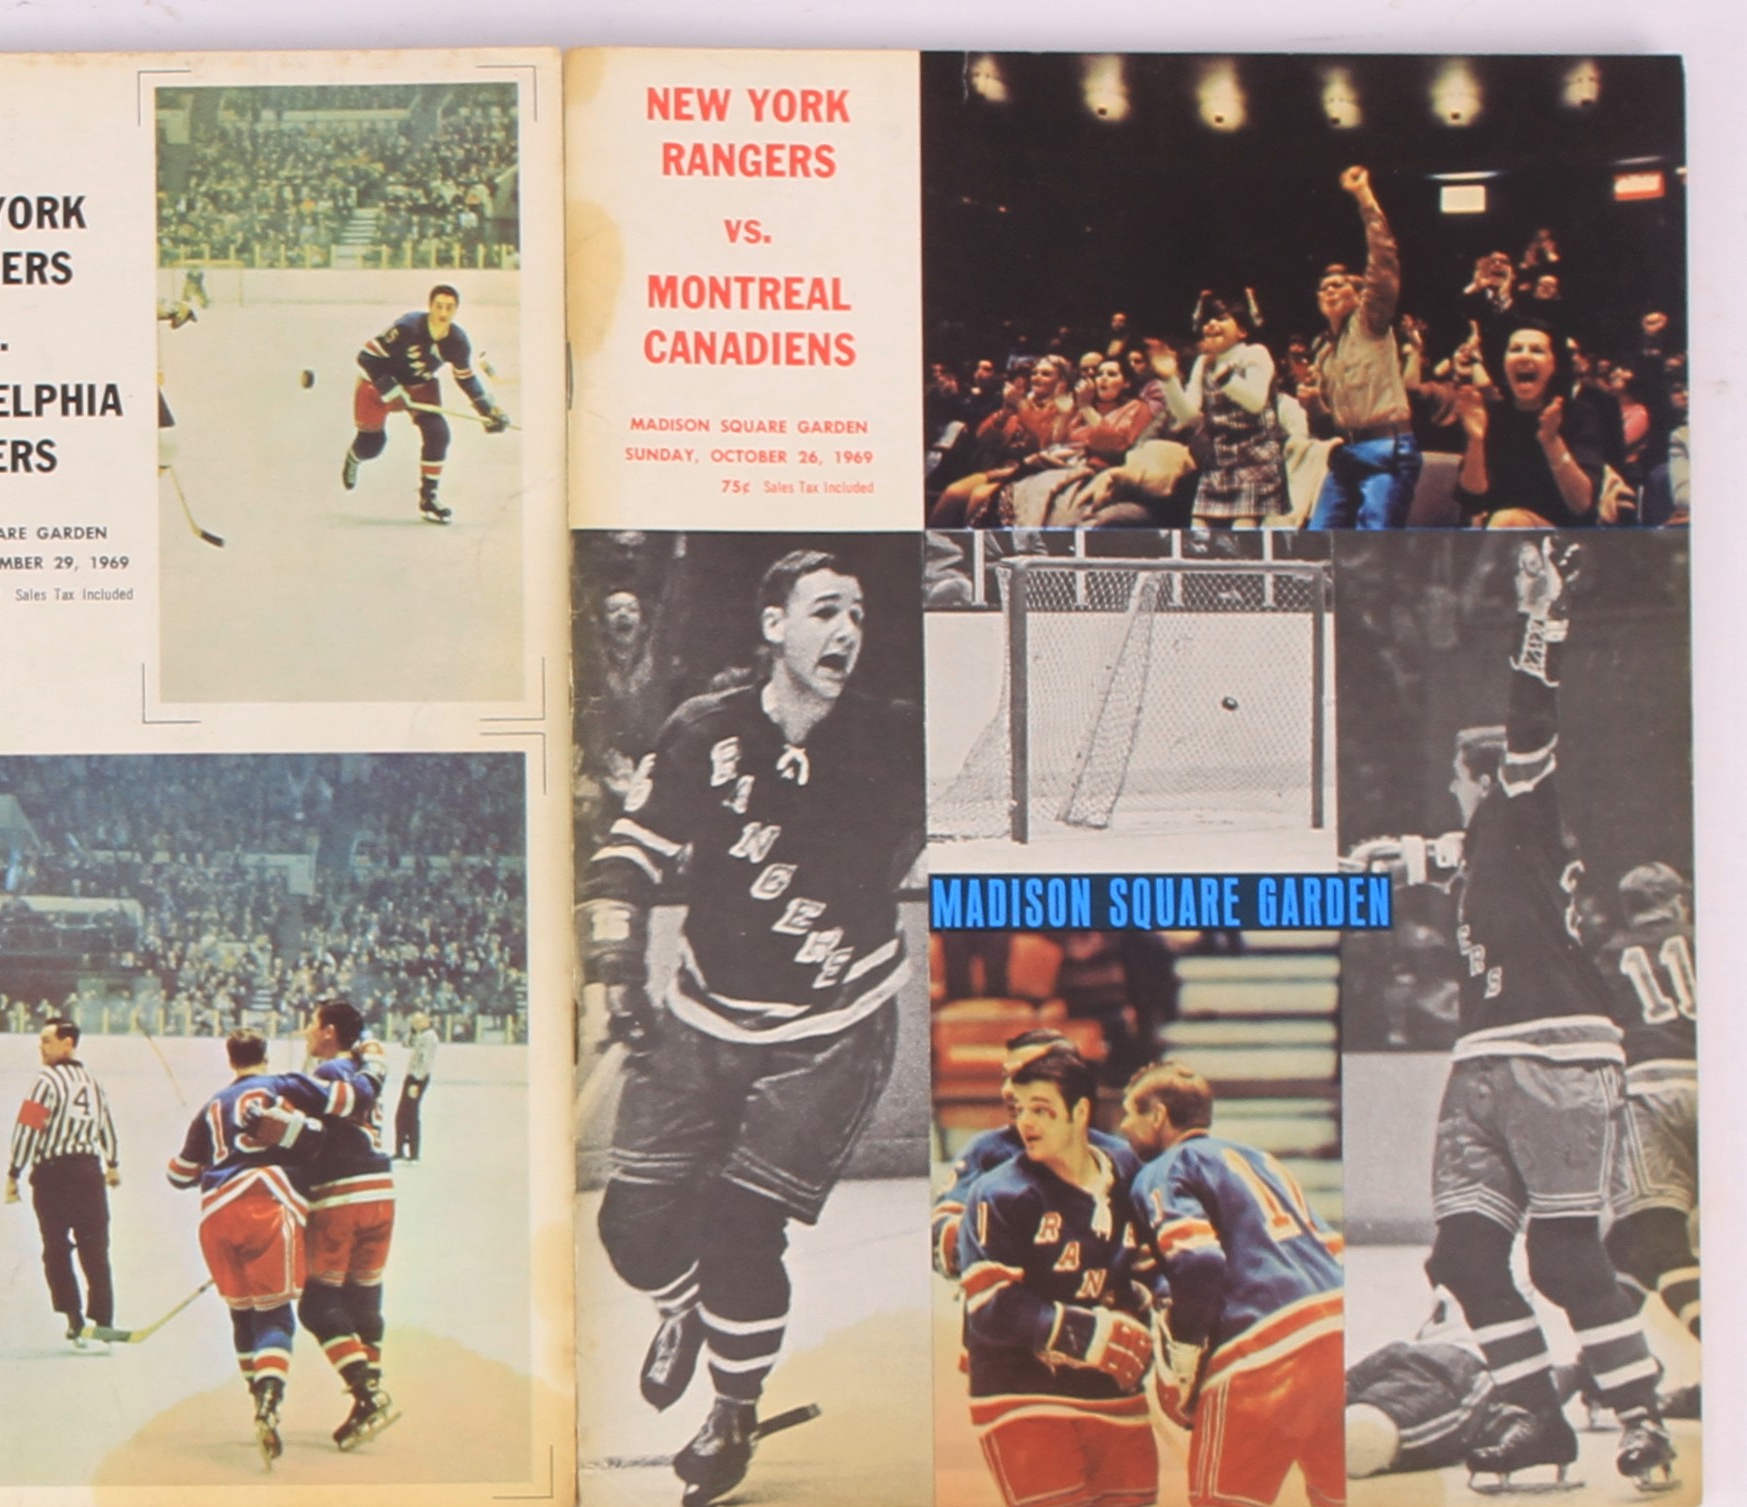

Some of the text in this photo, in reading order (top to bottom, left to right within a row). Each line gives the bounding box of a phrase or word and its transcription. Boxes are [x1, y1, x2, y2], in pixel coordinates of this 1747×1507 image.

[646, 86, 851, 124] NEW YORK
[661, 141, 837, 179] RANGERS
[646, 273, 853, 312] MONTREAL
[643, 328, 857, 368] CANADIENS
[629, 417, 869, 435] MADISON SQUARE GARDEN
[624, 447, 874, 467] SUNDAY, OCTOBER 26, 1969
[721, 479, 875, 495] 75¢ Sales Tax Included
[36, 526, 107, 540] GARDEN
[54, 555, 79, 573] 29,
[91, 555, 130, 570] 1969
[15, 588, 47, 601] Sales
[55, 588, 74, 601] Tax
[82, 588, 134, 601] Included
[931, 875, 1391, 930] MADISON SQUARE GARDEN
[72, 1084, 92, 1116] 4
